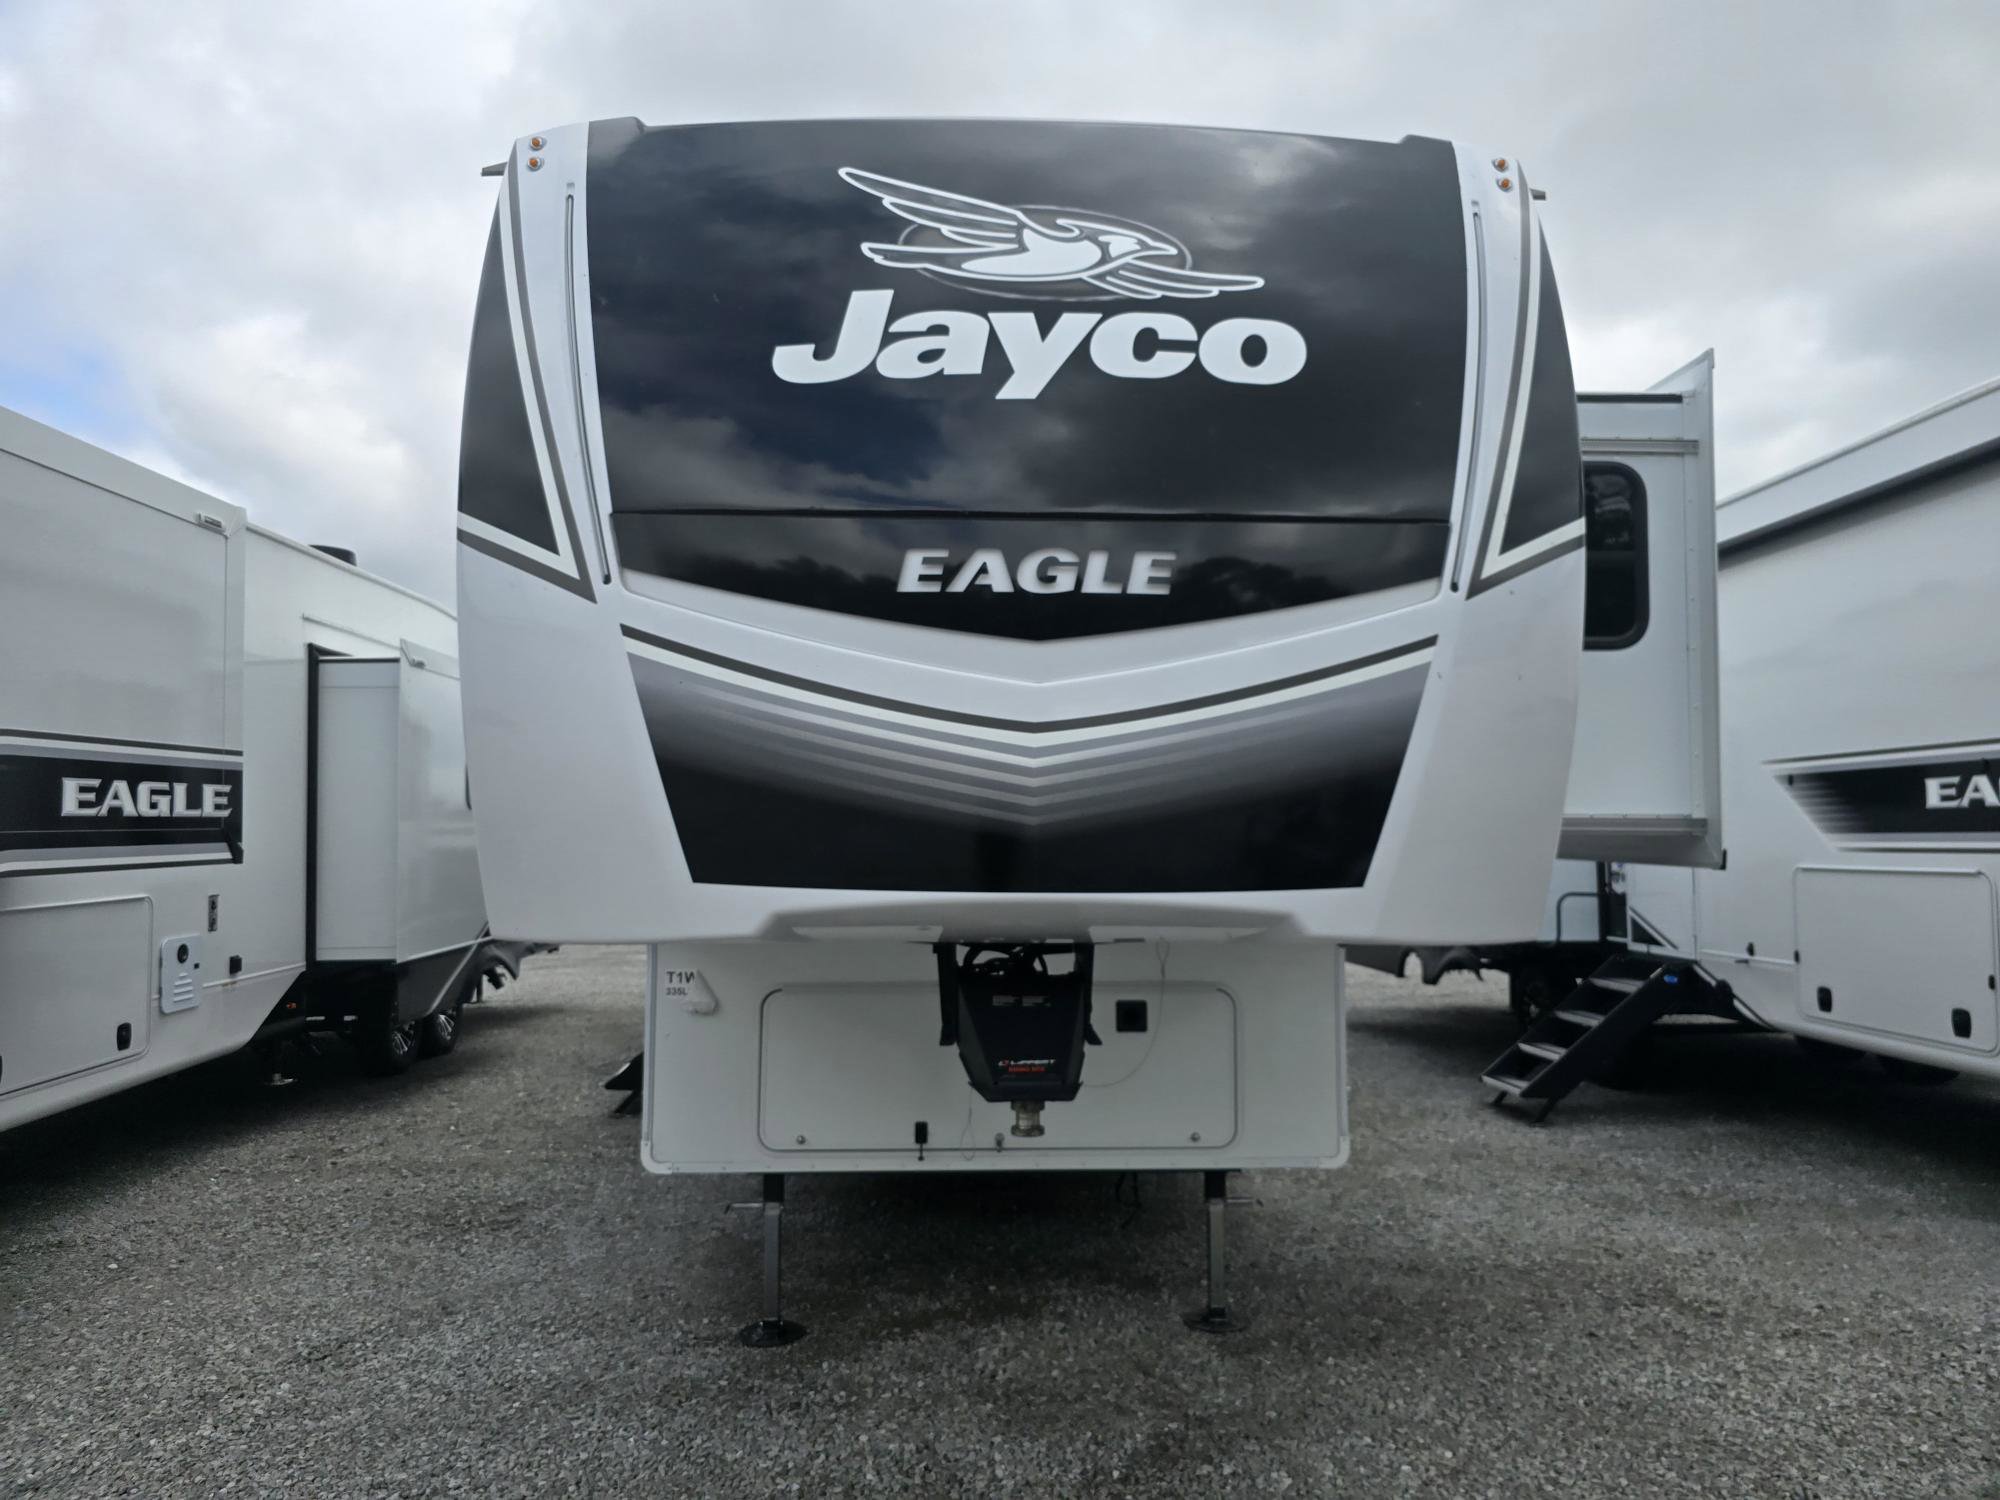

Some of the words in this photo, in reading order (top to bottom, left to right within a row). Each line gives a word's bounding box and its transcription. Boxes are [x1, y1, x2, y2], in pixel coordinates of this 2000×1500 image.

[771, 289, 1307, 400] Jayco
[896, 548, 1177, 595] EAGLE
[60, 776, 233, 818] EAGLE
